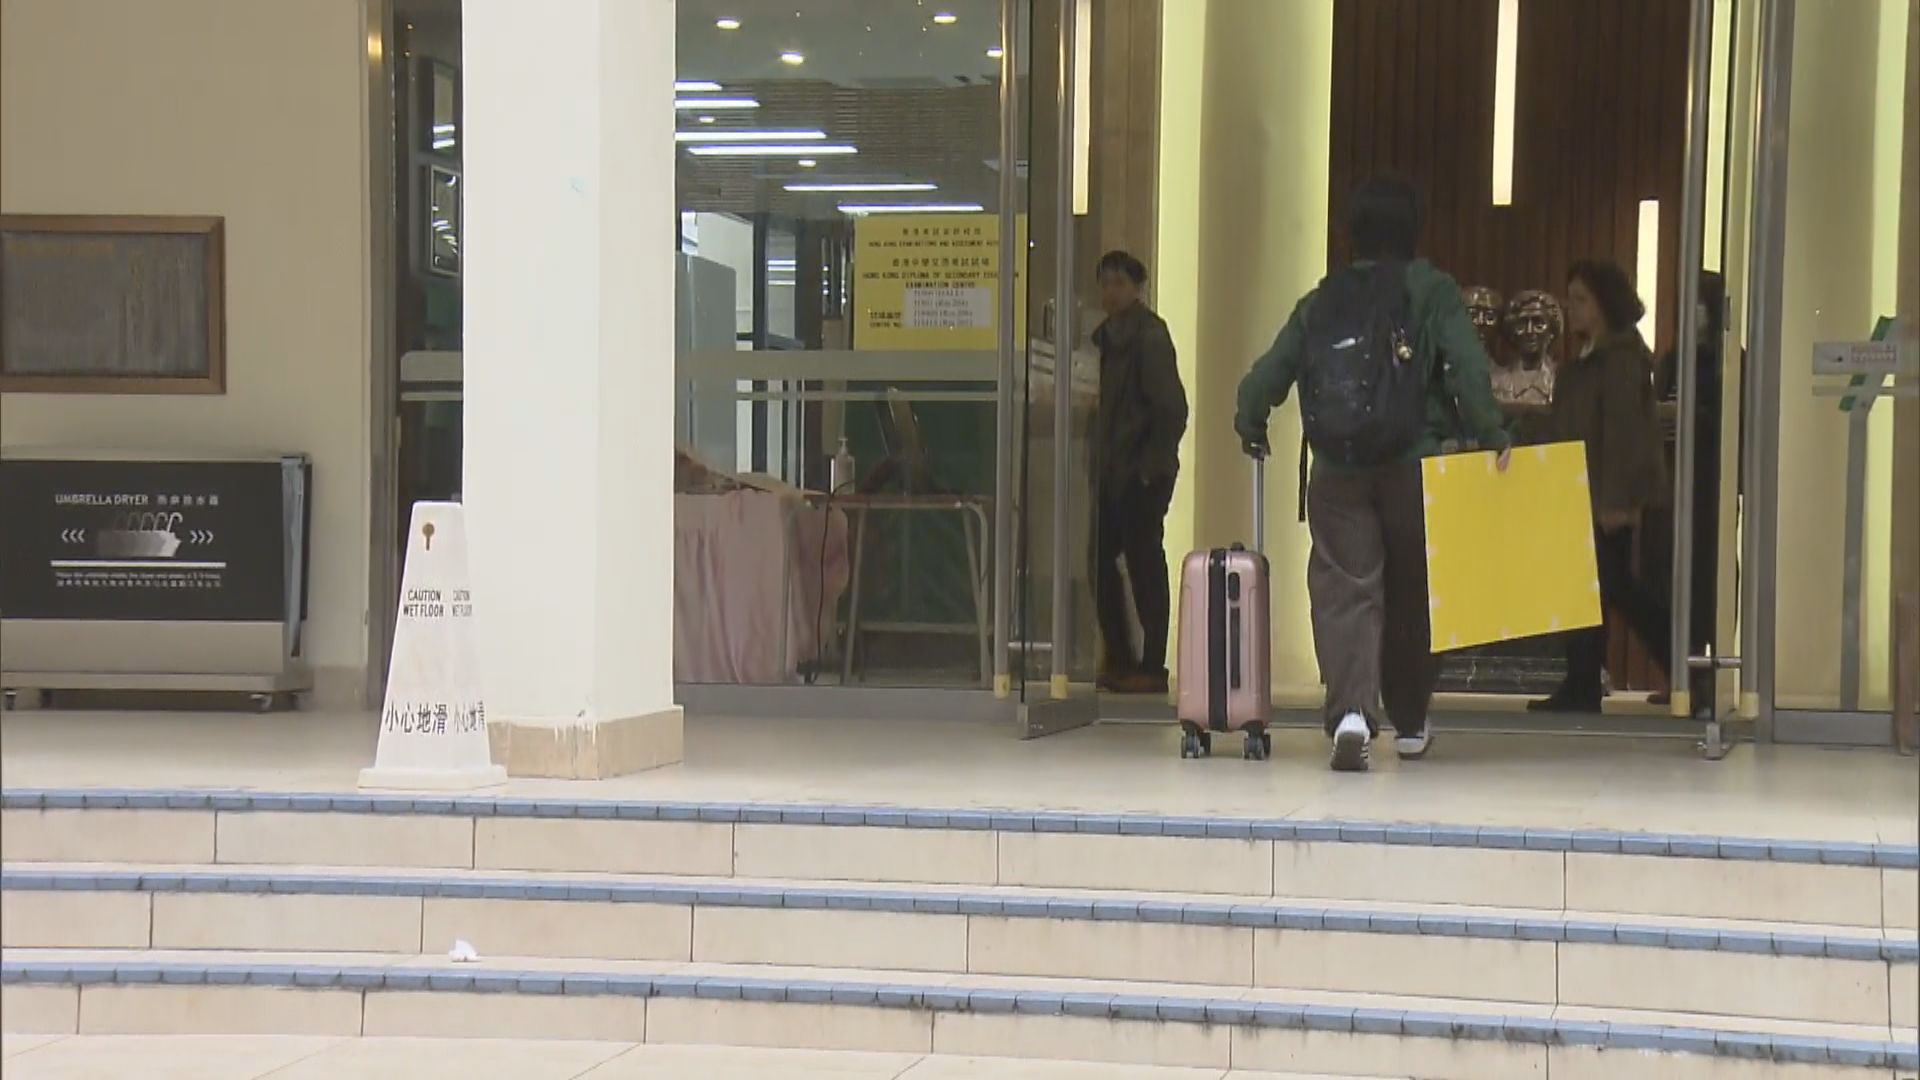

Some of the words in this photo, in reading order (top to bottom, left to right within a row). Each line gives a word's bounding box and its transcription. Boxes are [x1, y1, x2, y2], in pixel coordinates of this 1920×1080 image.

[55, 494, 112, 505] UMBRELLA
[114, 494, 149, 505] DRYER
[407, 590, 441, 601] CAUTION
[403, 604, 418, 617] WET
[420, 604, 444, 617] FLOOR
[385, 701, 448, 734] 小心地滑
